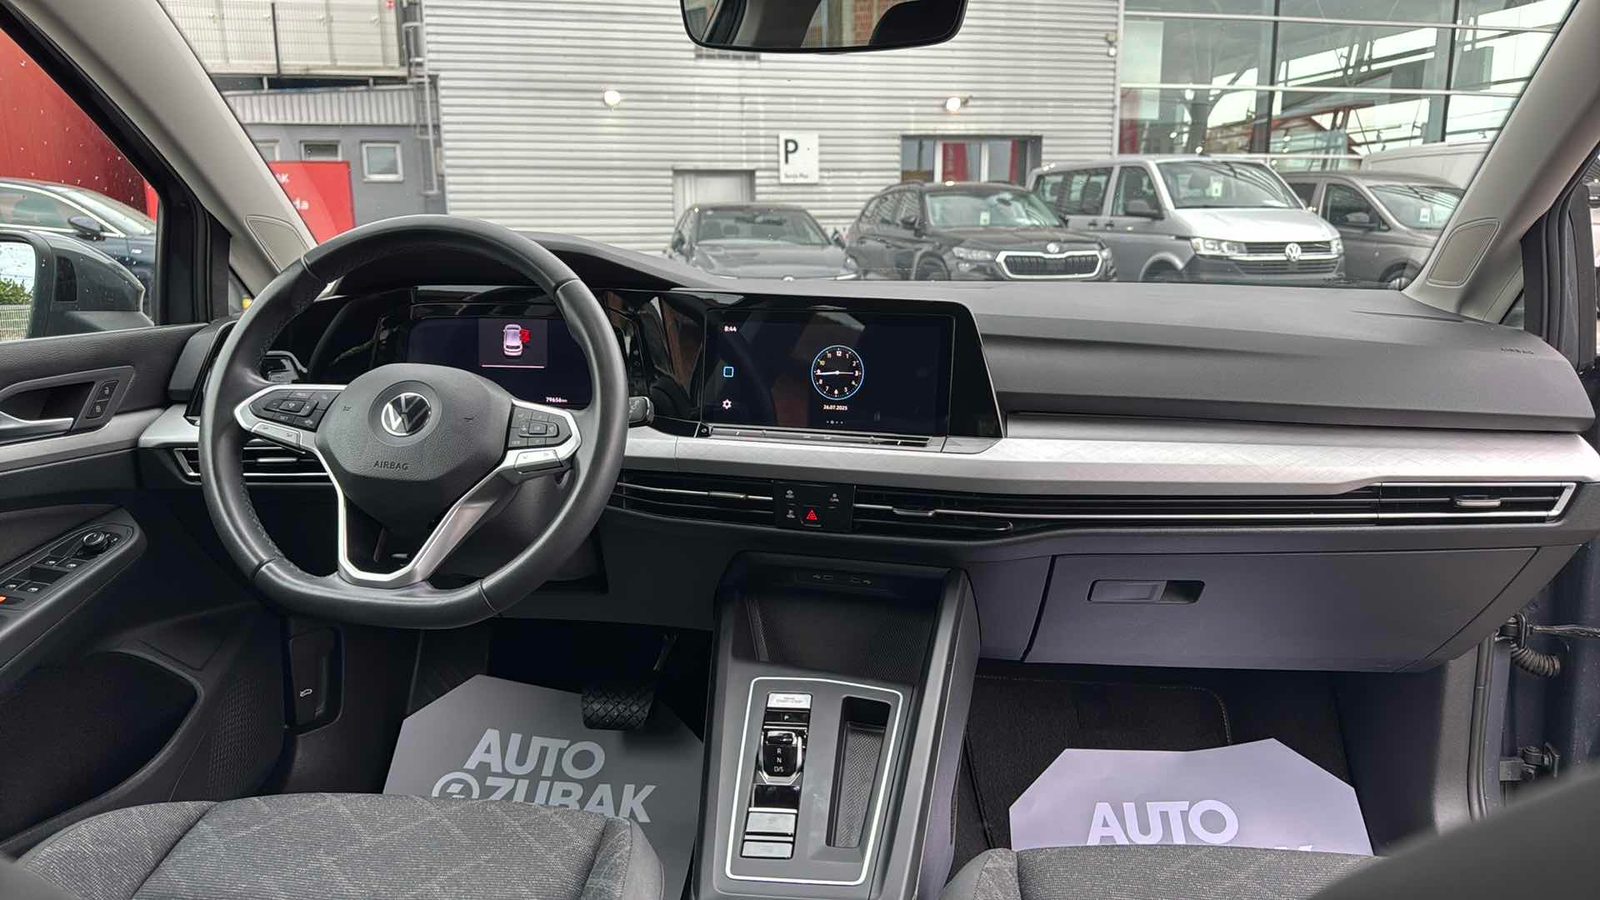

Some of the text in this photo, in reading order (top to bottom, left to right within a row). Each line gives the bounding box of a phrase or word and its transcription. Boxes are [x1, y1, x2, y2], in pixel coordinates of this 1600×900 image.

[784, 138, 799, 165] P
[373, 460, 409, 471] AIRBAG
[463, 728, 606, 780] AUTO
[1086, 799, 1239, 846] AUTO
